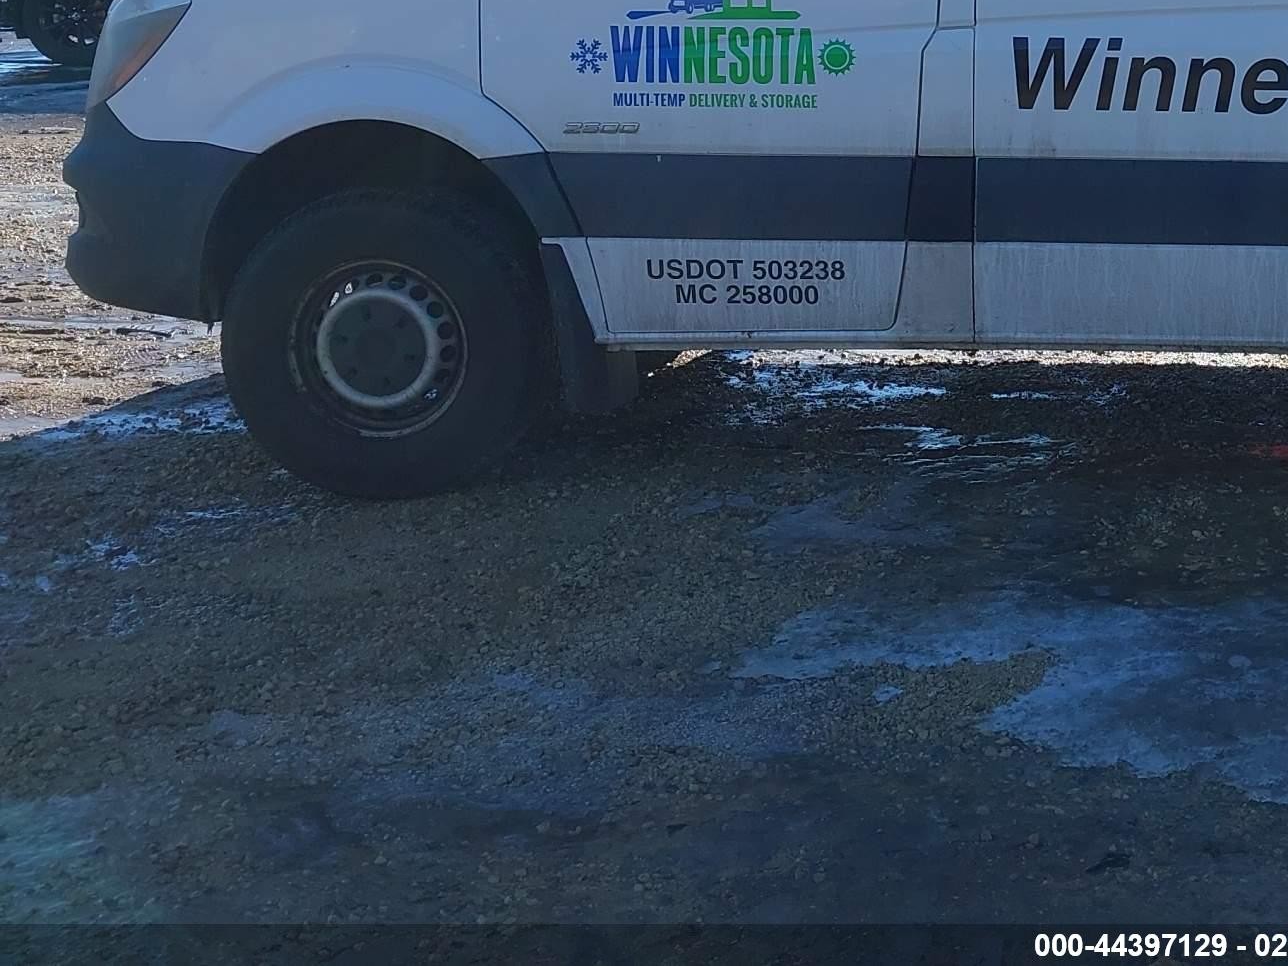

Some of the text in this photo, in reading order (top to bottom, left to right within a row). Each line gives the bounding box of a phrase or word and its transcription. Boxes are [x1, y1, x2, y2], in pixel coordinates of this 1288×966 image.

[610, 25, 816, 84] WINNESOTA
[613, 93, 817, 109] MULTI-TEMP DELIVERY & STORAGE
[562, 121, 640, 134] 2500
[647, 259, 845, 280] USDOT 503238
[676, 284, 818, 305] MC 258000
